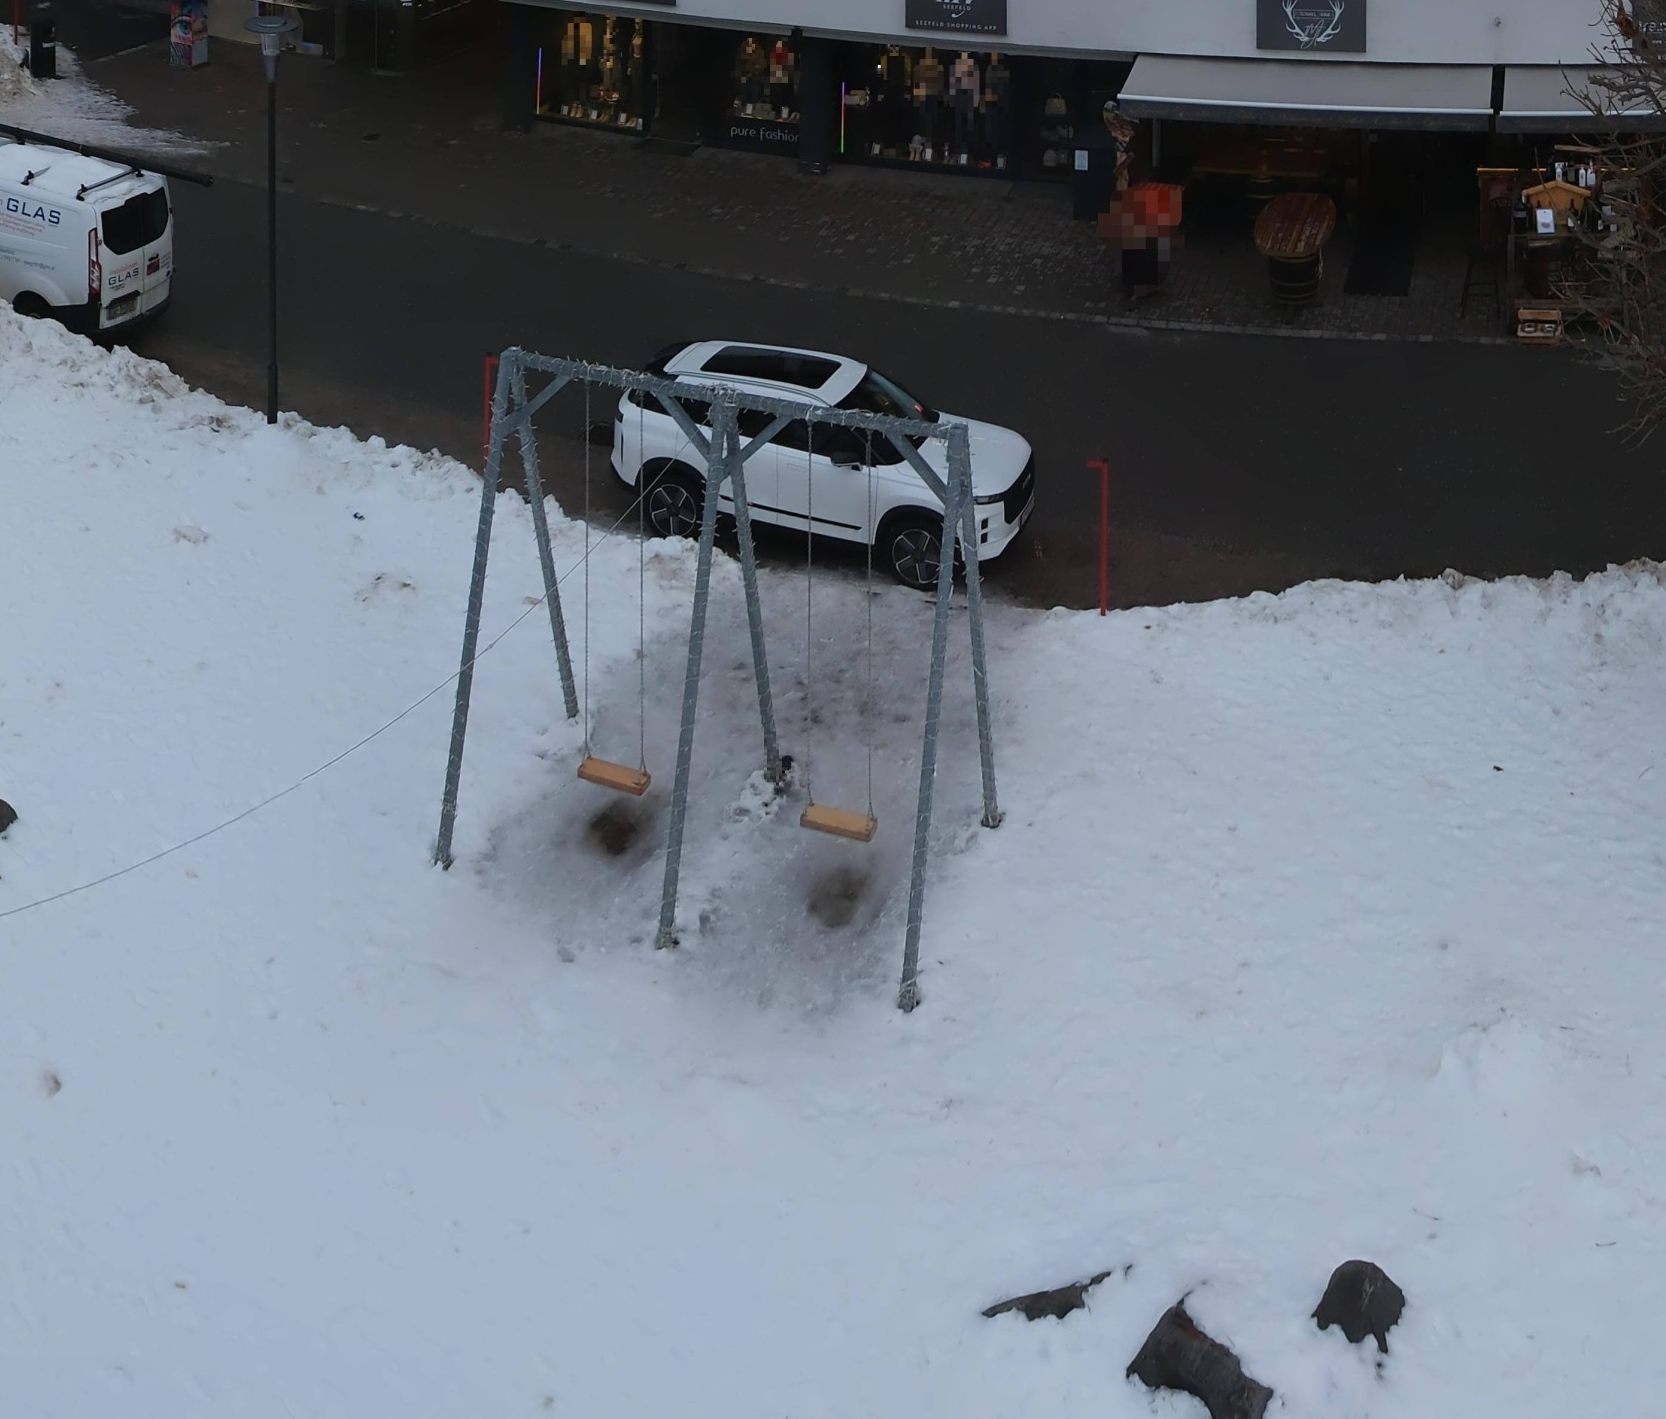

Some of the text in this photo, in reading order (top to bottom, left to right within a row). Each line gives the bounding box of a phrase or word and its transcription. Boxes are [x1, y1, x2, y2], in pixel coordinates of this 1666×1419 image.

[947, 22, 982, 30] SHOPPING
[730, 126, 756, 138] pure
[6, 198, 62, 225] GLAS
[108, 267, 140, 286] GLAS
